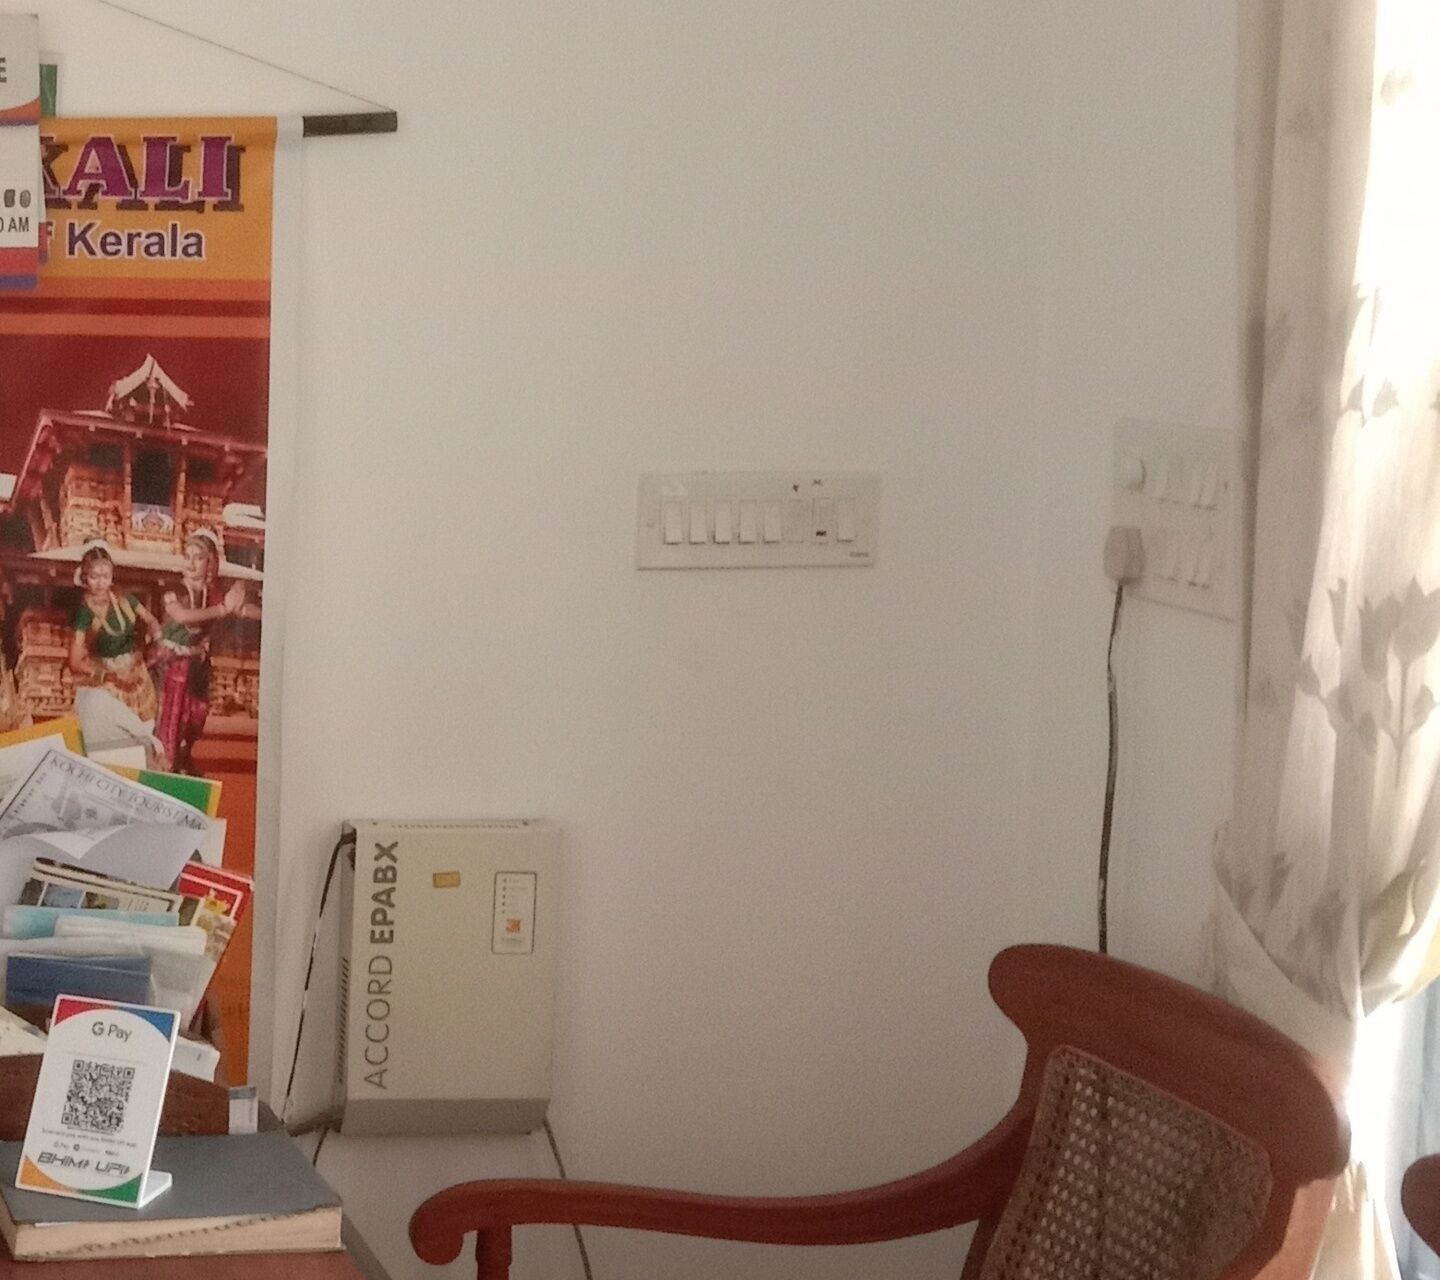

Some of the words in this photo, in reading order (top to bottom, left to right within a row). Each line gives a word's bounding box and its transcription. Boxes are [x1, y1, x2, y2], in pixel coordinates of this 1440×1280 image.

[8, 217, 30, 233] AM
[67, 222, 204, 258] Kerala
[369, 840, 399, 944] EPABX
[107, 1024, 133, 1043] Pay
[363, 954, 393, 1090] ACCORD
